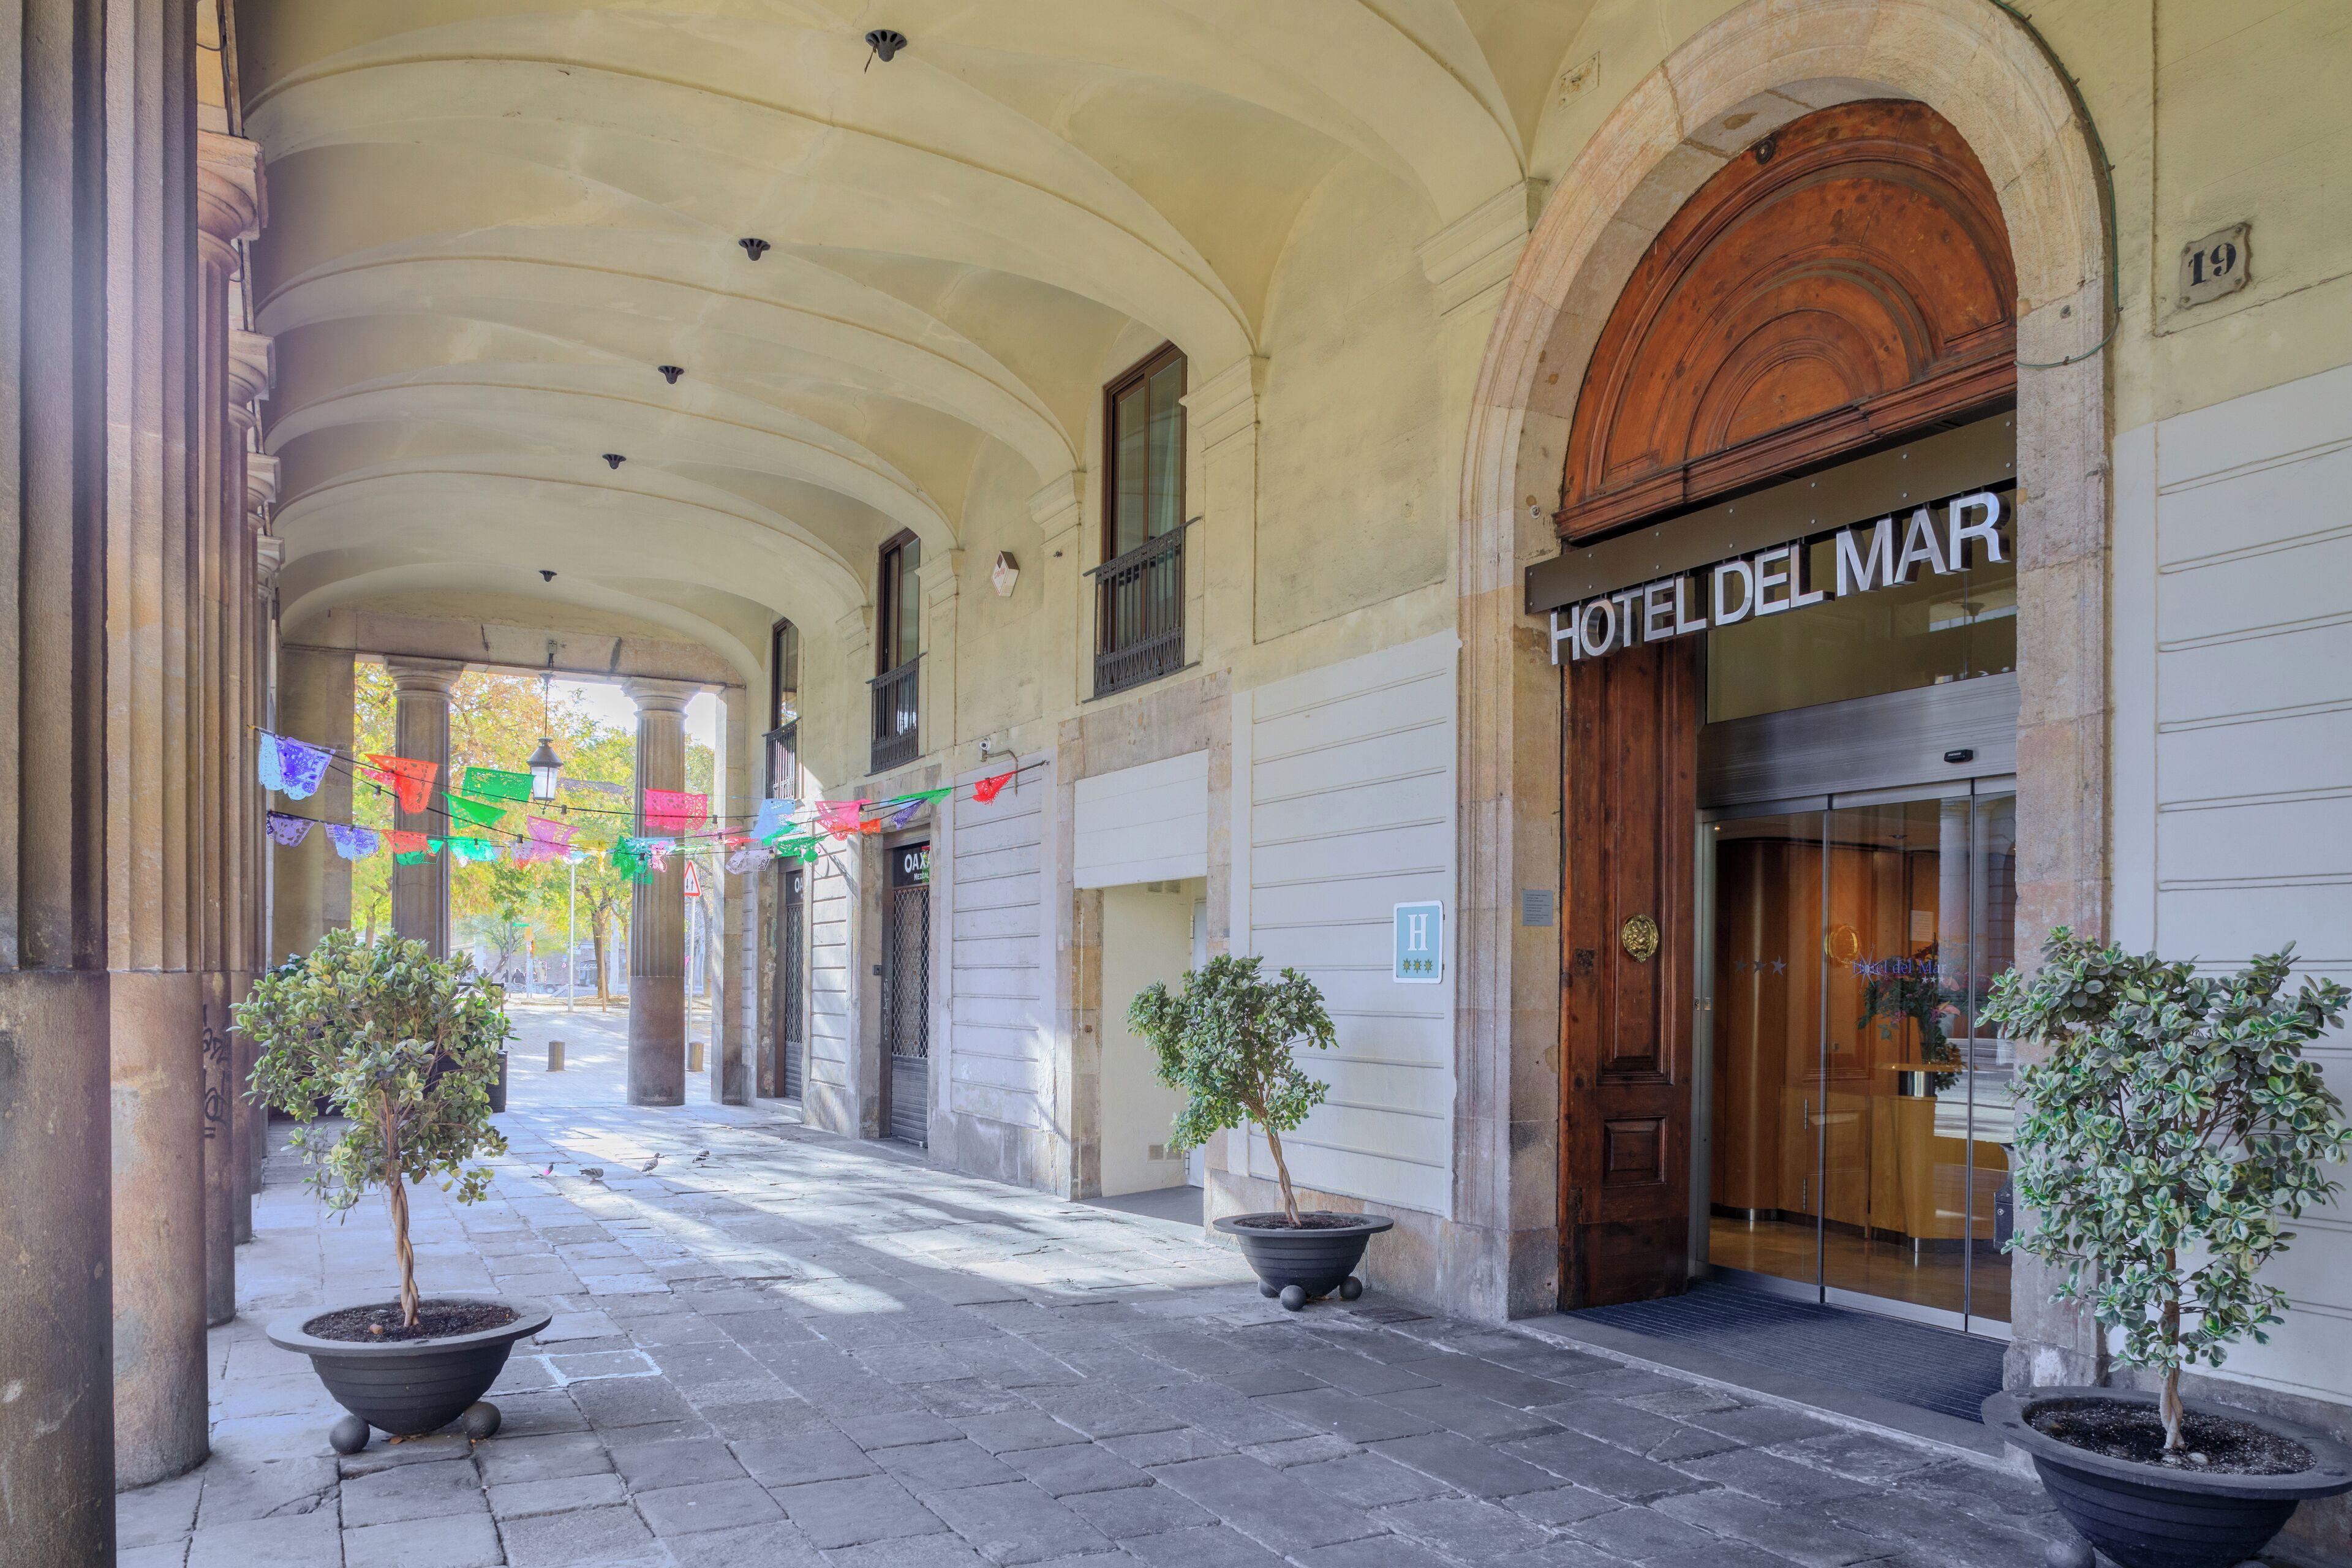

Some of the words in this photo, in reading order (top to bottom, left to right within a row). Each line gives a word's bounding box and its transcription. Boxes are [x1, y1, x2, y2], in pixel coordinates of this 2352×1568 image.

[2188, 243, 2236, 286] 19
[1550, 573, 1713, 665] HOTEL
[1715, 543, 1834, 627] DEL
[1837, 491, 2011, 597] MAR
[1408, 914, 1428, 951] H
[1853, 960, 1888, 974] Hotel
[1892, 958, 1912, 974] del
[1919, 959, 1947, 974] Mar
